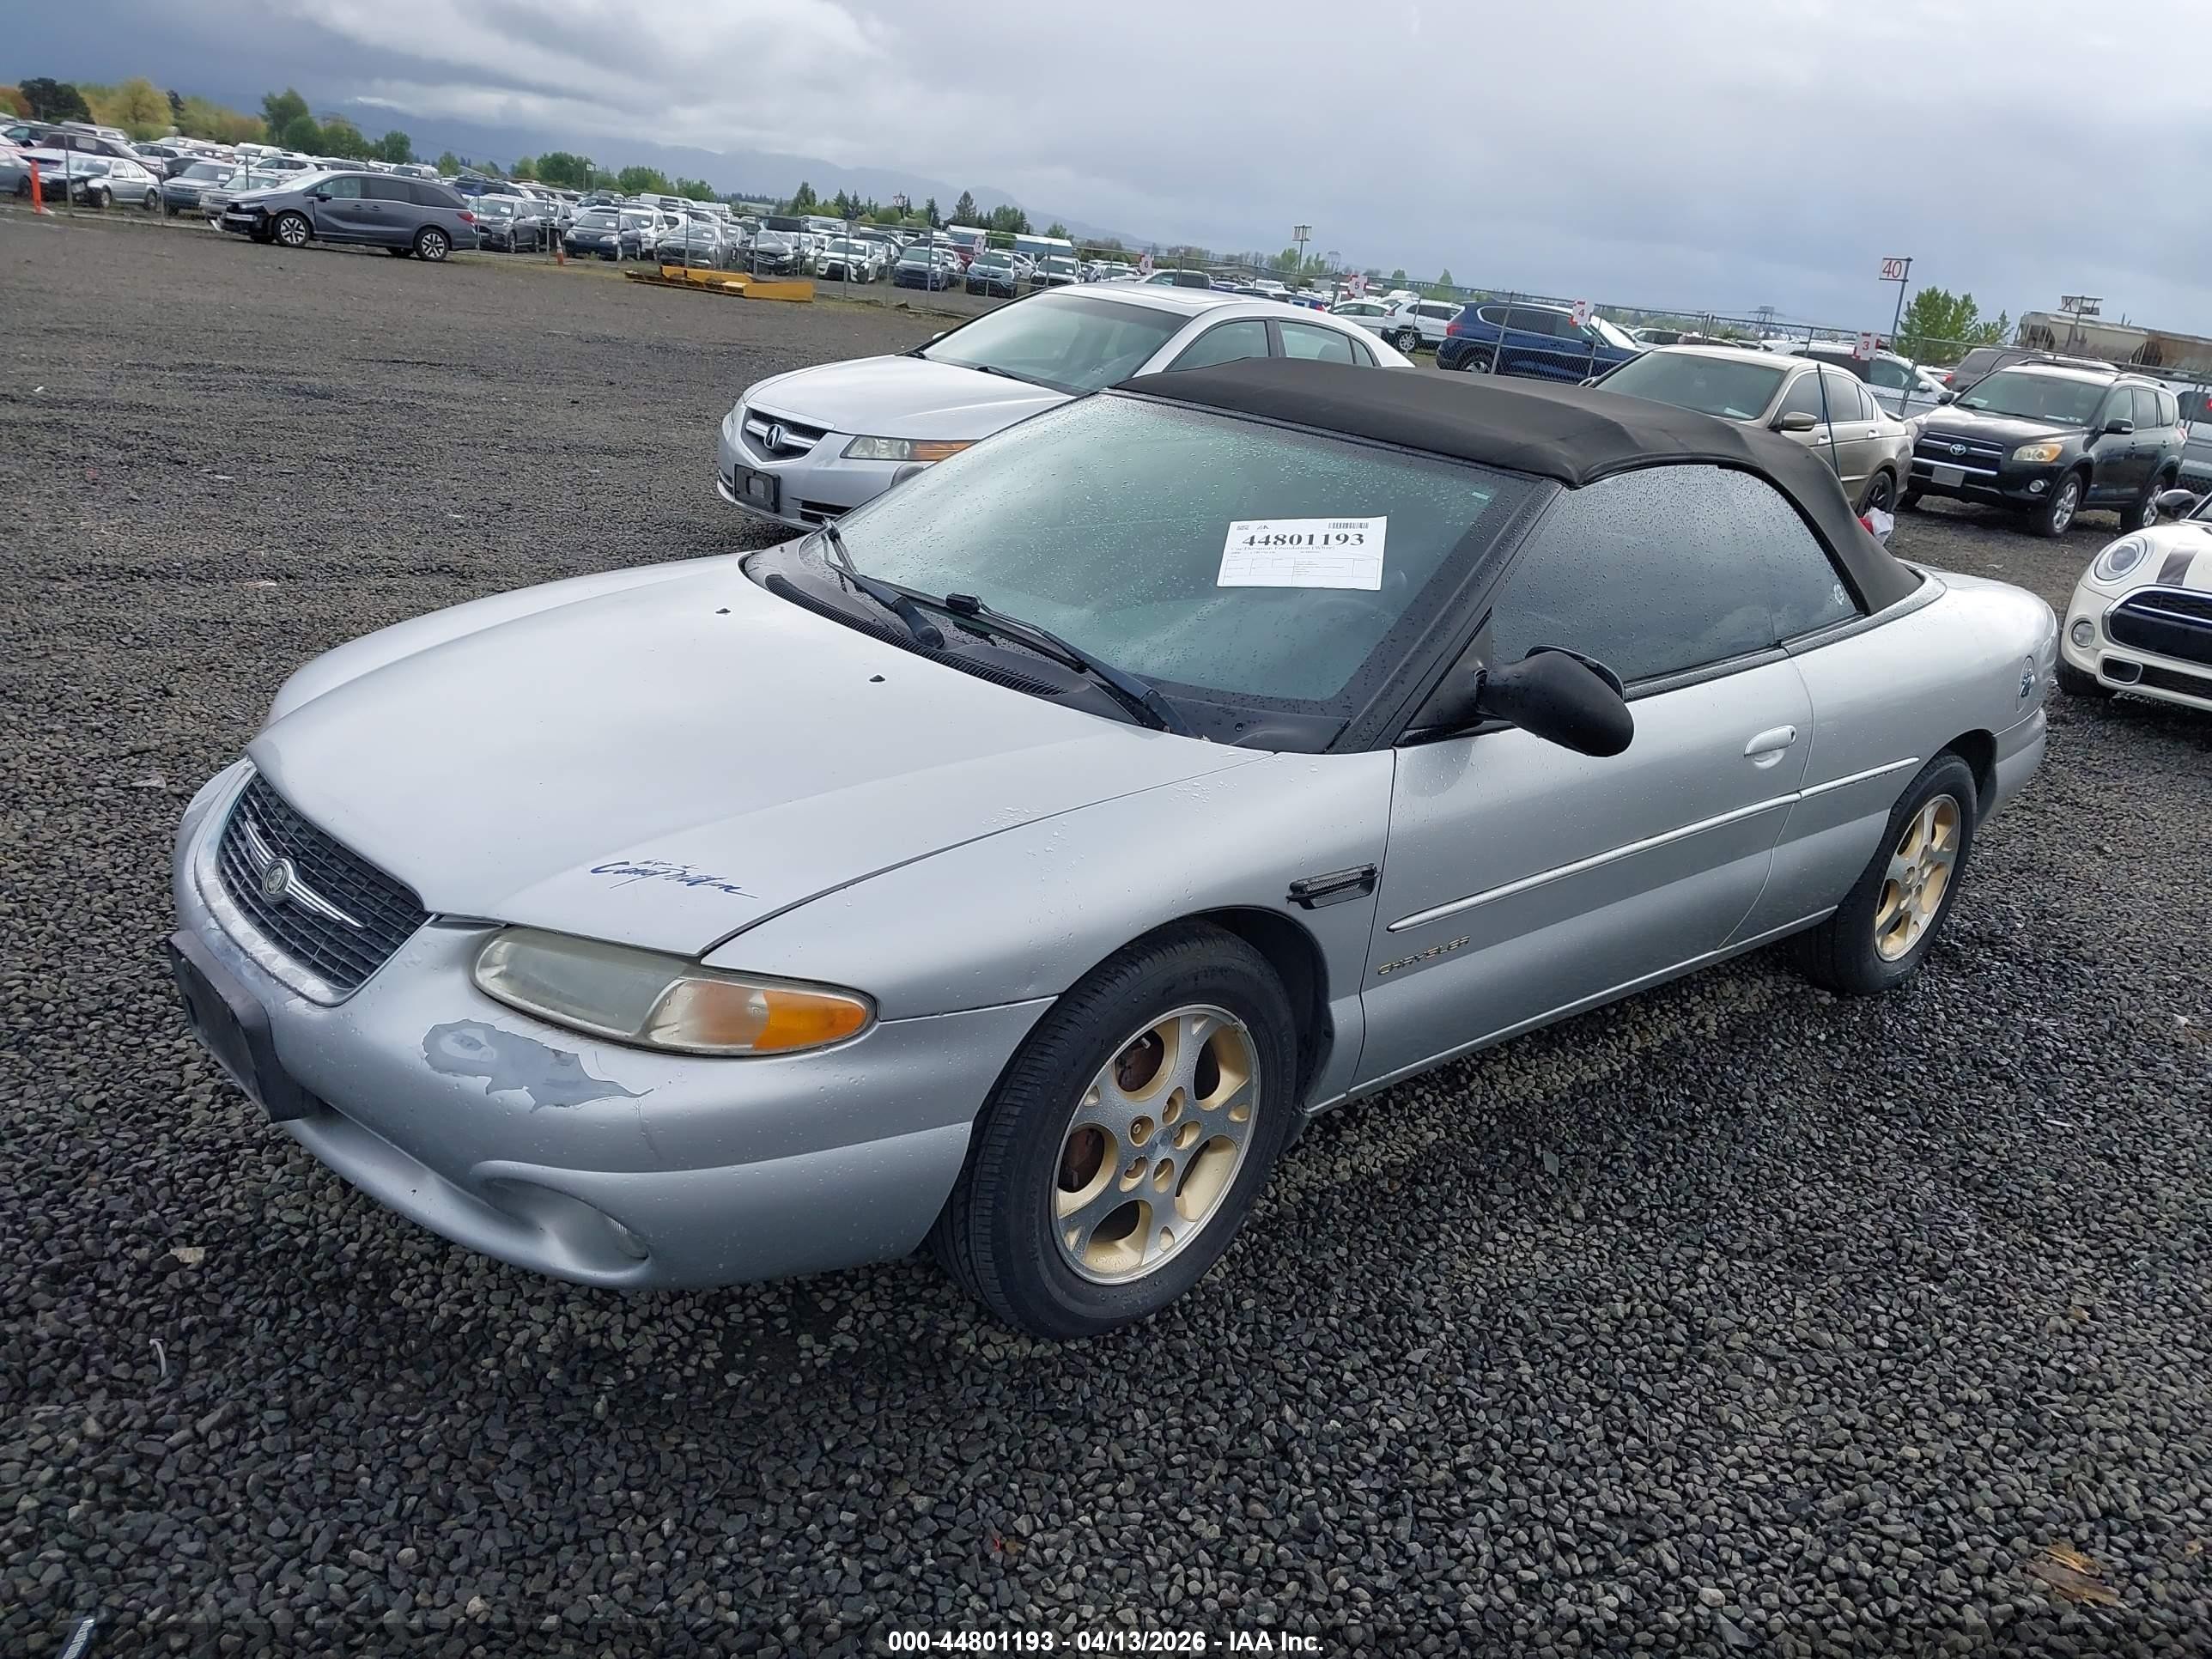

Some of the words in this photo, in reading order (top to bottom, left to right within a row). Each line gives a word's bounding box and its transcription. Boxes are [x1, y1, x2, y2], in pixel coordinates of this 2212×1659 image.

[1882, 260, 1902, 278] 40
[1354, 281, 1360, 289] 5
[1863, 341, 1869, 350] 3
[1242, 533, 1364, 546] 44801193
[1378, 935, 1470, 975] CHRYSLER
